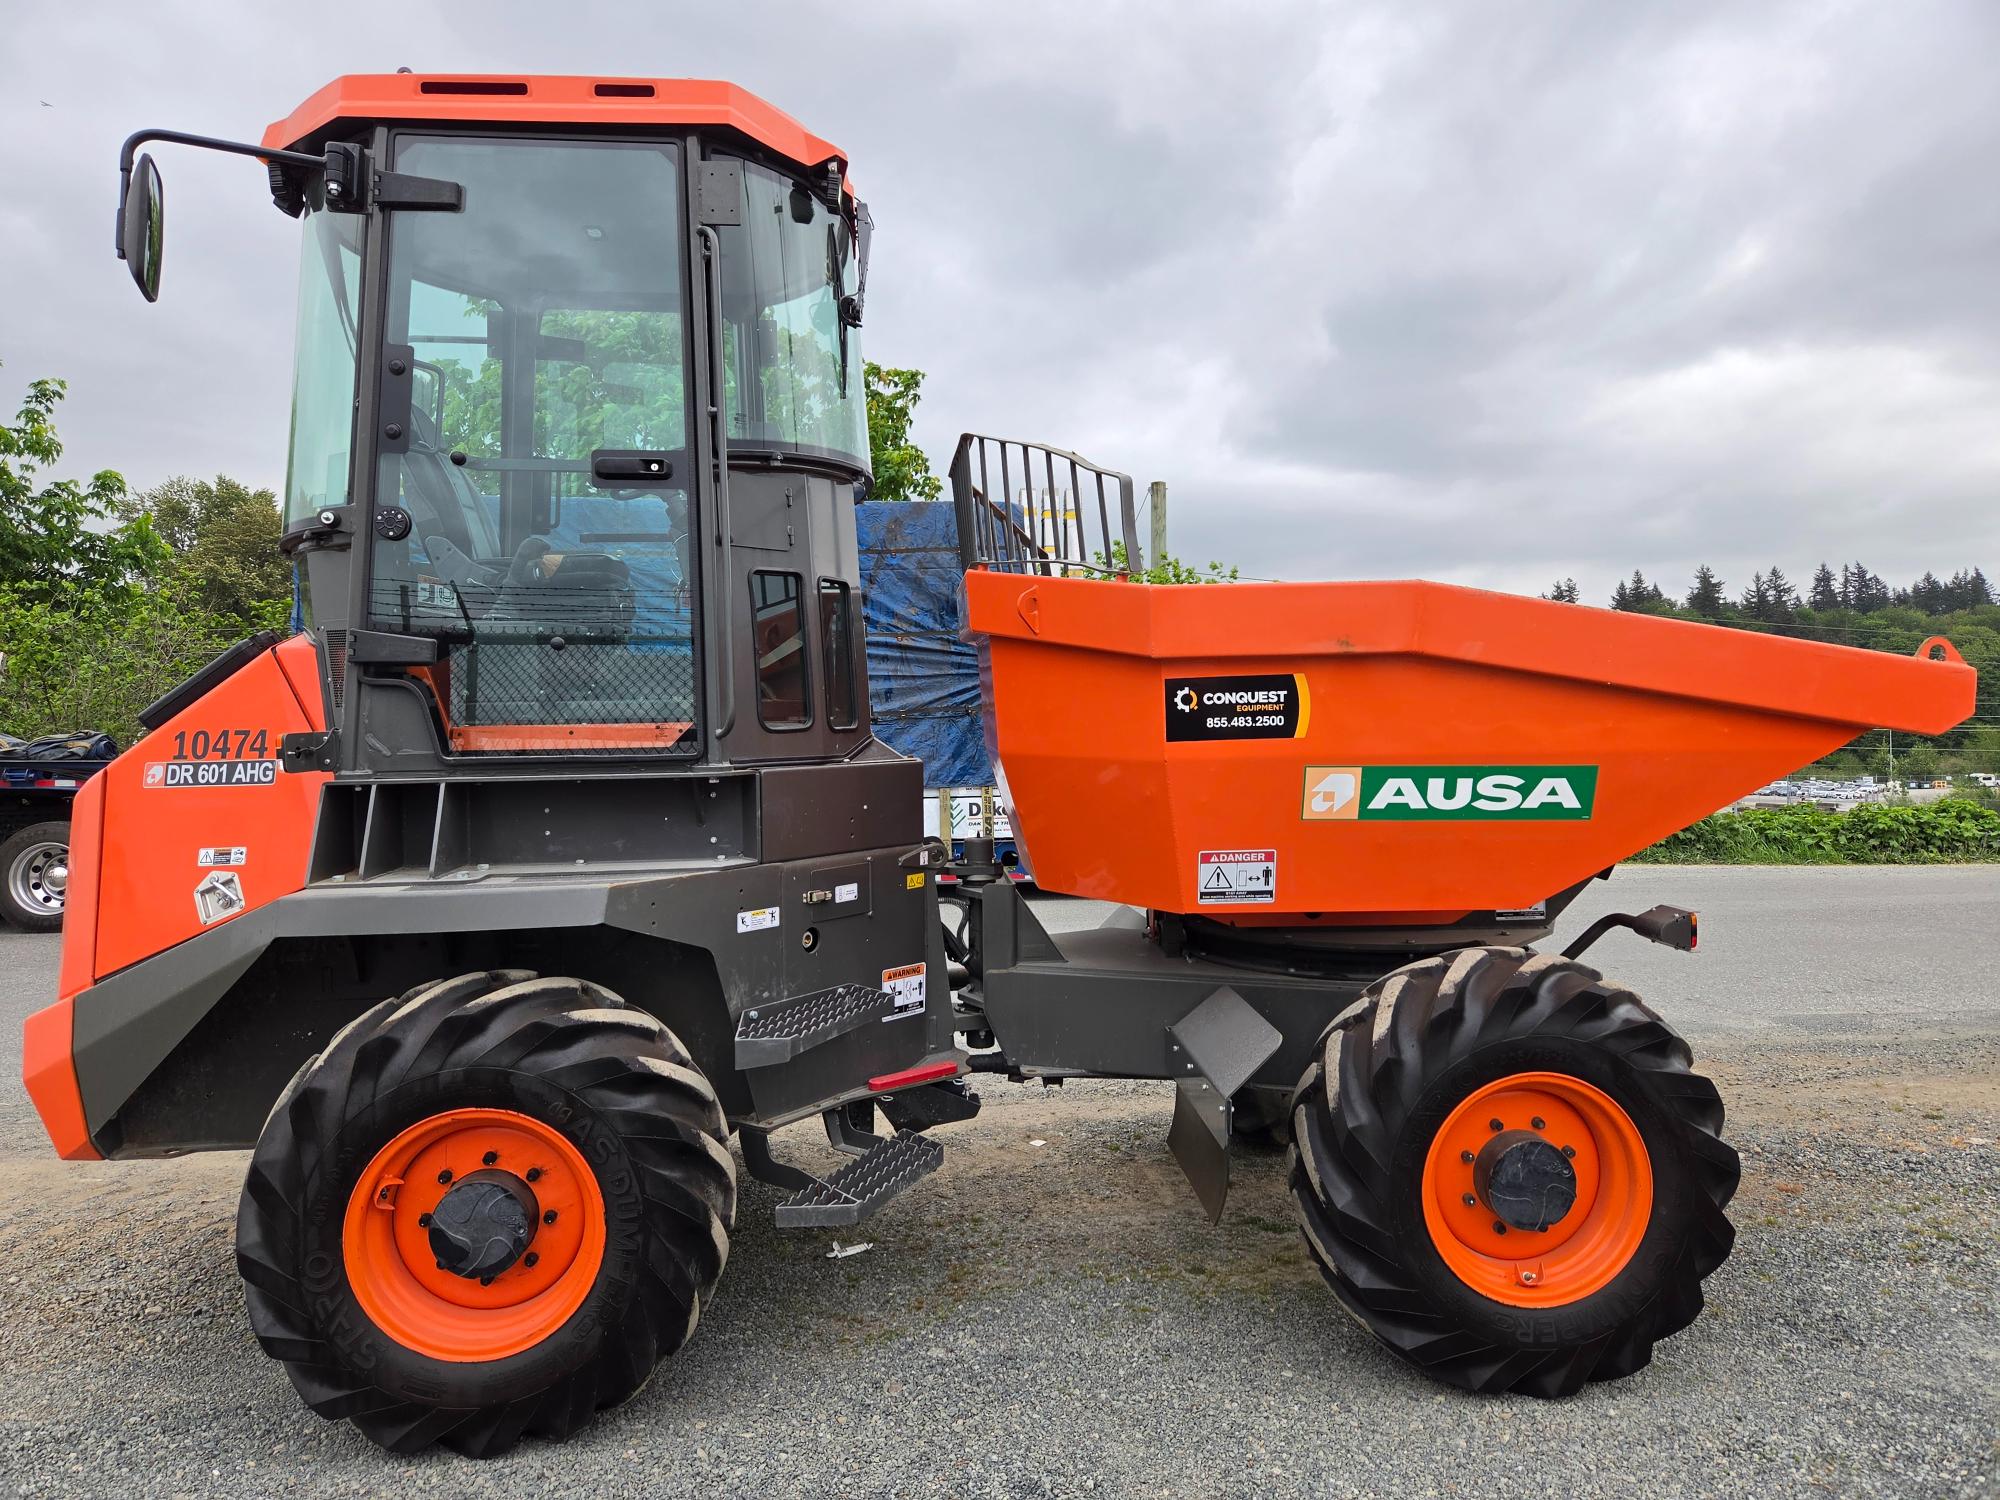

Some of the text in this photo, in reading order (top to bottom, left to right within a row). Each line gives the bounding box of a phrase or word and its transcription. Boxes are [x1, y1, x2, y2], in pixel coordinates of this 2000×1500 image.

[1203, 690, 1288, 705] CONQUEST
[1236, 703, 1285, 712] EQUIPMENT
[1206, 715, 1285, 728] 855.483.2500
[172, 729, 269, 760] 10474
[166, 762, 274, 785] DR 601 AHG
[1366, 774, 1582, 811] AUSA
[1220, 853, 1265, 862] DANGER
[892, 966, 921, 978] WARNING
